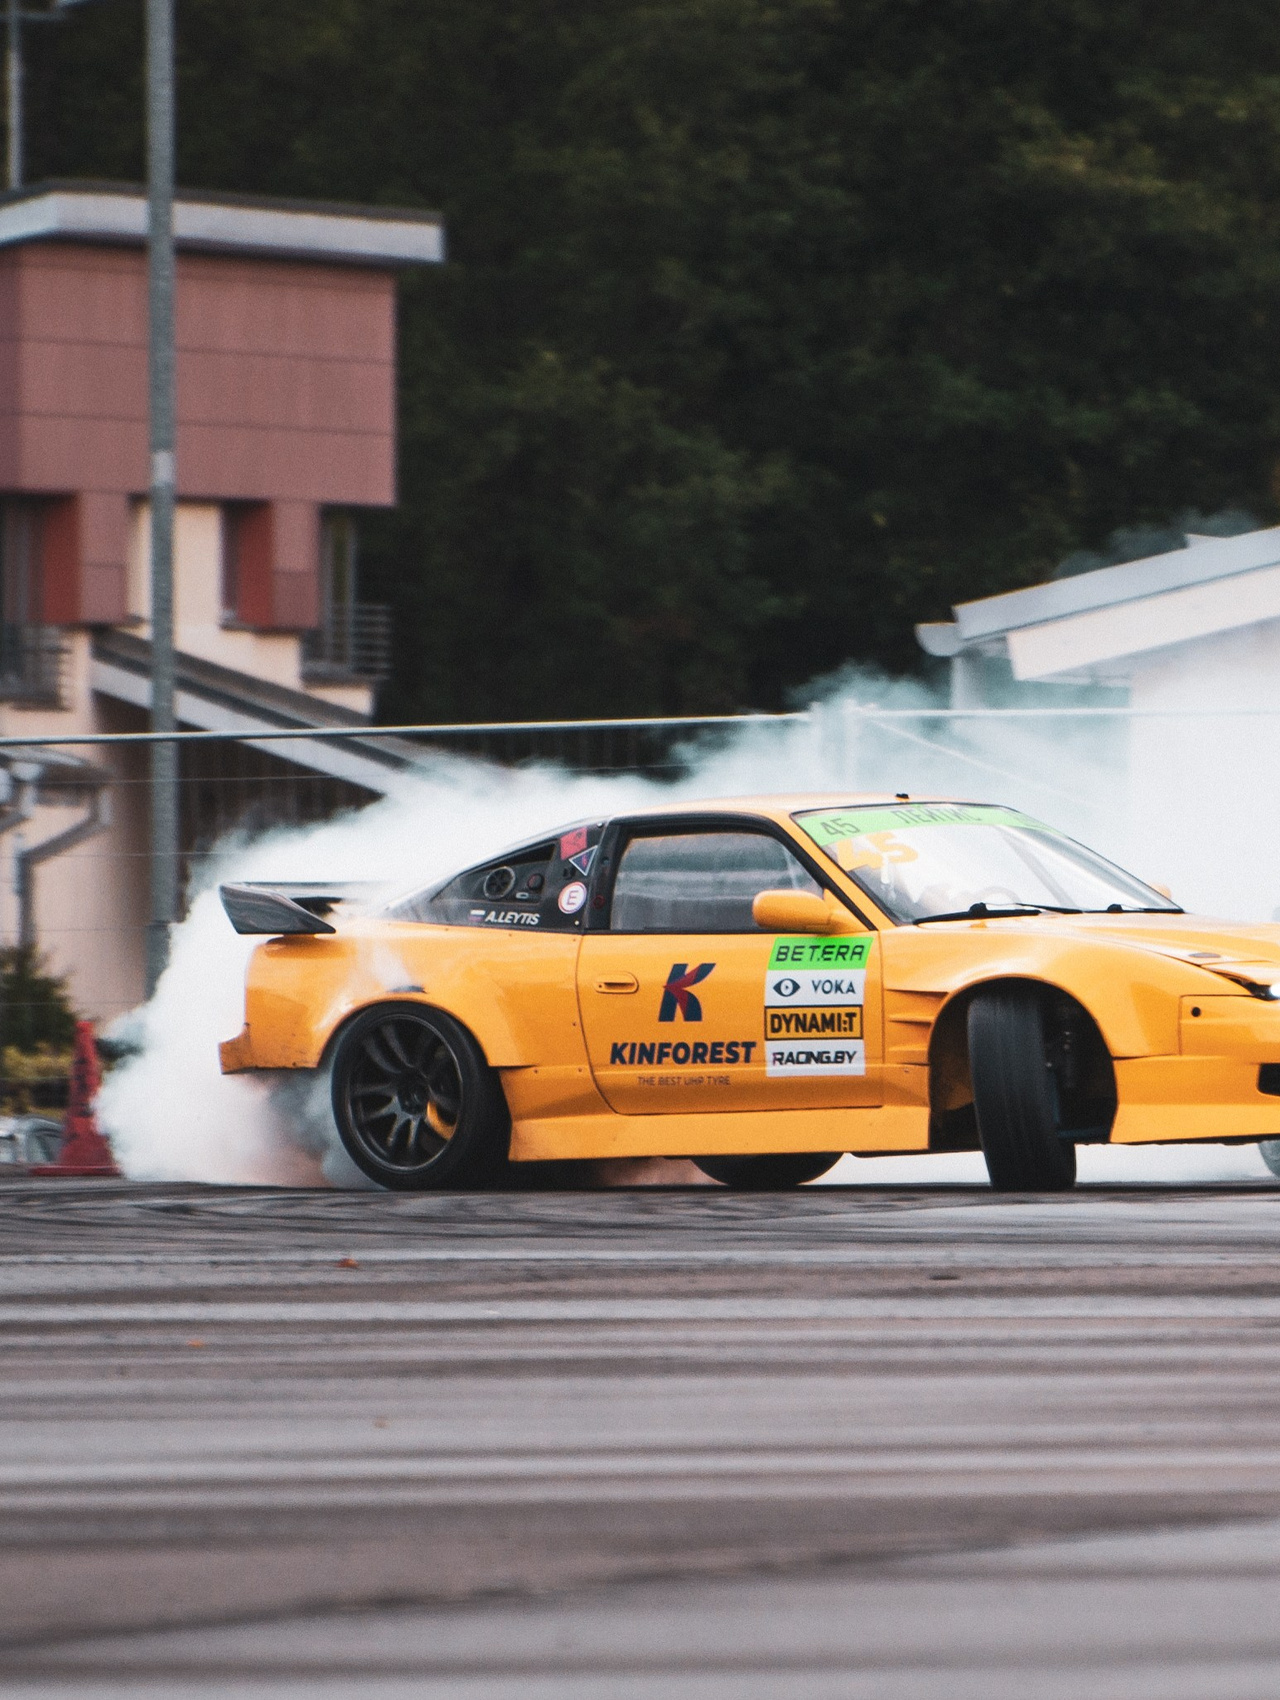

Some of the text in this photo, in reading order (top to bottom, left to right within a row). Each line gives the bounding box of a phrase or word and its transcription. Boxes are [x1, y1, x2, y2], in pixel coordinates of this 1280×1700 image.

[820, 818, 861, 836] 45
[485, 911, 540, 925] A.LEYTIS
[811, 979, 856, 995] VOKA
[610, 1041, 756, 1065] KINFOREST
